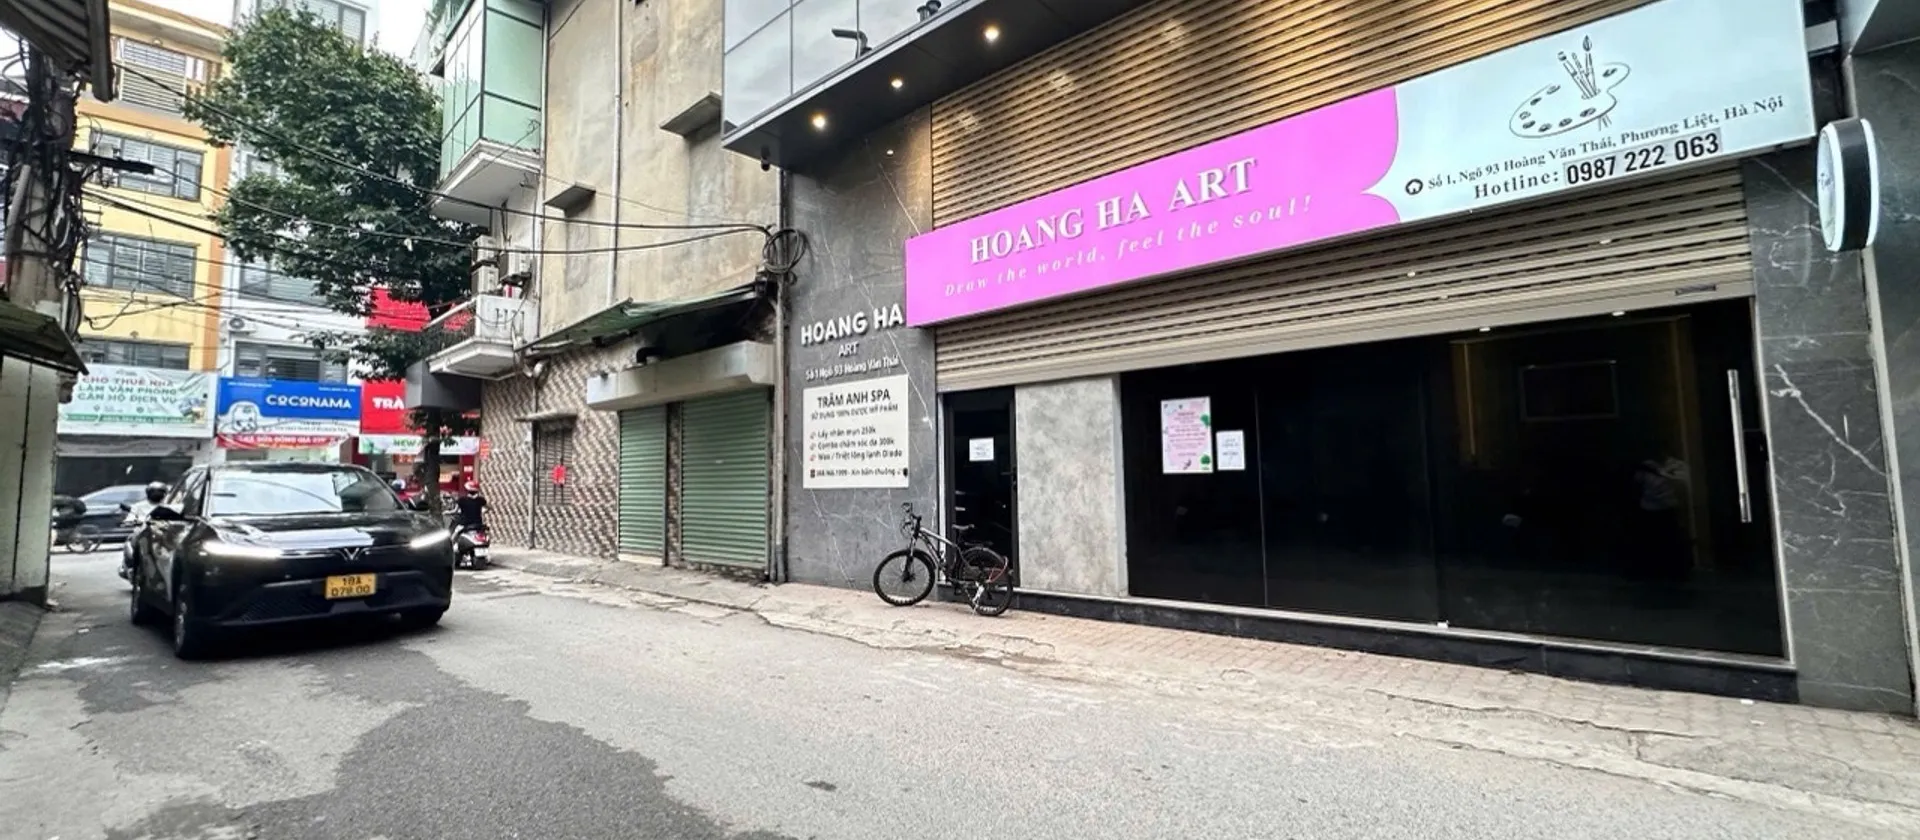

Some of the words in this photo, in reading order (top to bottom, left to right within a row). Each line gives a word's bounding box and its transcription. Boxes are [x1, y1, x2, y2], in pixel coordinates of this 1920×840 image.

[1428, 174, 1443, 190] Số
[1459, 168, 1483, 183] Ngõ
[1486, 163, 1500, 175] 93
[1504, 154, 1546, 172] Hoàng
[1548, 146, 1576, 160] Văn
[1621, 123, 1679, 144] Phương
[1724, 104, 1748, 120] Hà
[1754, 95, 1784, 113] Nội
[1474, 171, 1559, 199] Hotline:
[1567, 155, 1617, 185] 0987
[1624, 145, 1665, 172] 222
[1675, 132, 1719, 161] 063
[970, 208, 1085, 264] HOANG
[1096, 191, 1151, 231] HA
[1168, 157, 1258, 212] ART
[945, 277, 988, 296] Draw
[998, 267, 1026, 283] the
[1117, 229, 1164, 260] feel
[1177, 220, 1219, 241] the
[1233, 195, 1312, 229] soul!
[801, 311, 868, 345] HOANG
[873, 303, 904, 329] HA
[839, 341, 859, 357] ART
[834, 365, 843, 376] 93
[82, 376, 109, 384] CHO
[265, 394, 352, 409] COCONAMA
[372, 395, 404, 410] TRÀ
[846, 391, 868, 405] ANH
[871, 388, 890, 402] SPA
